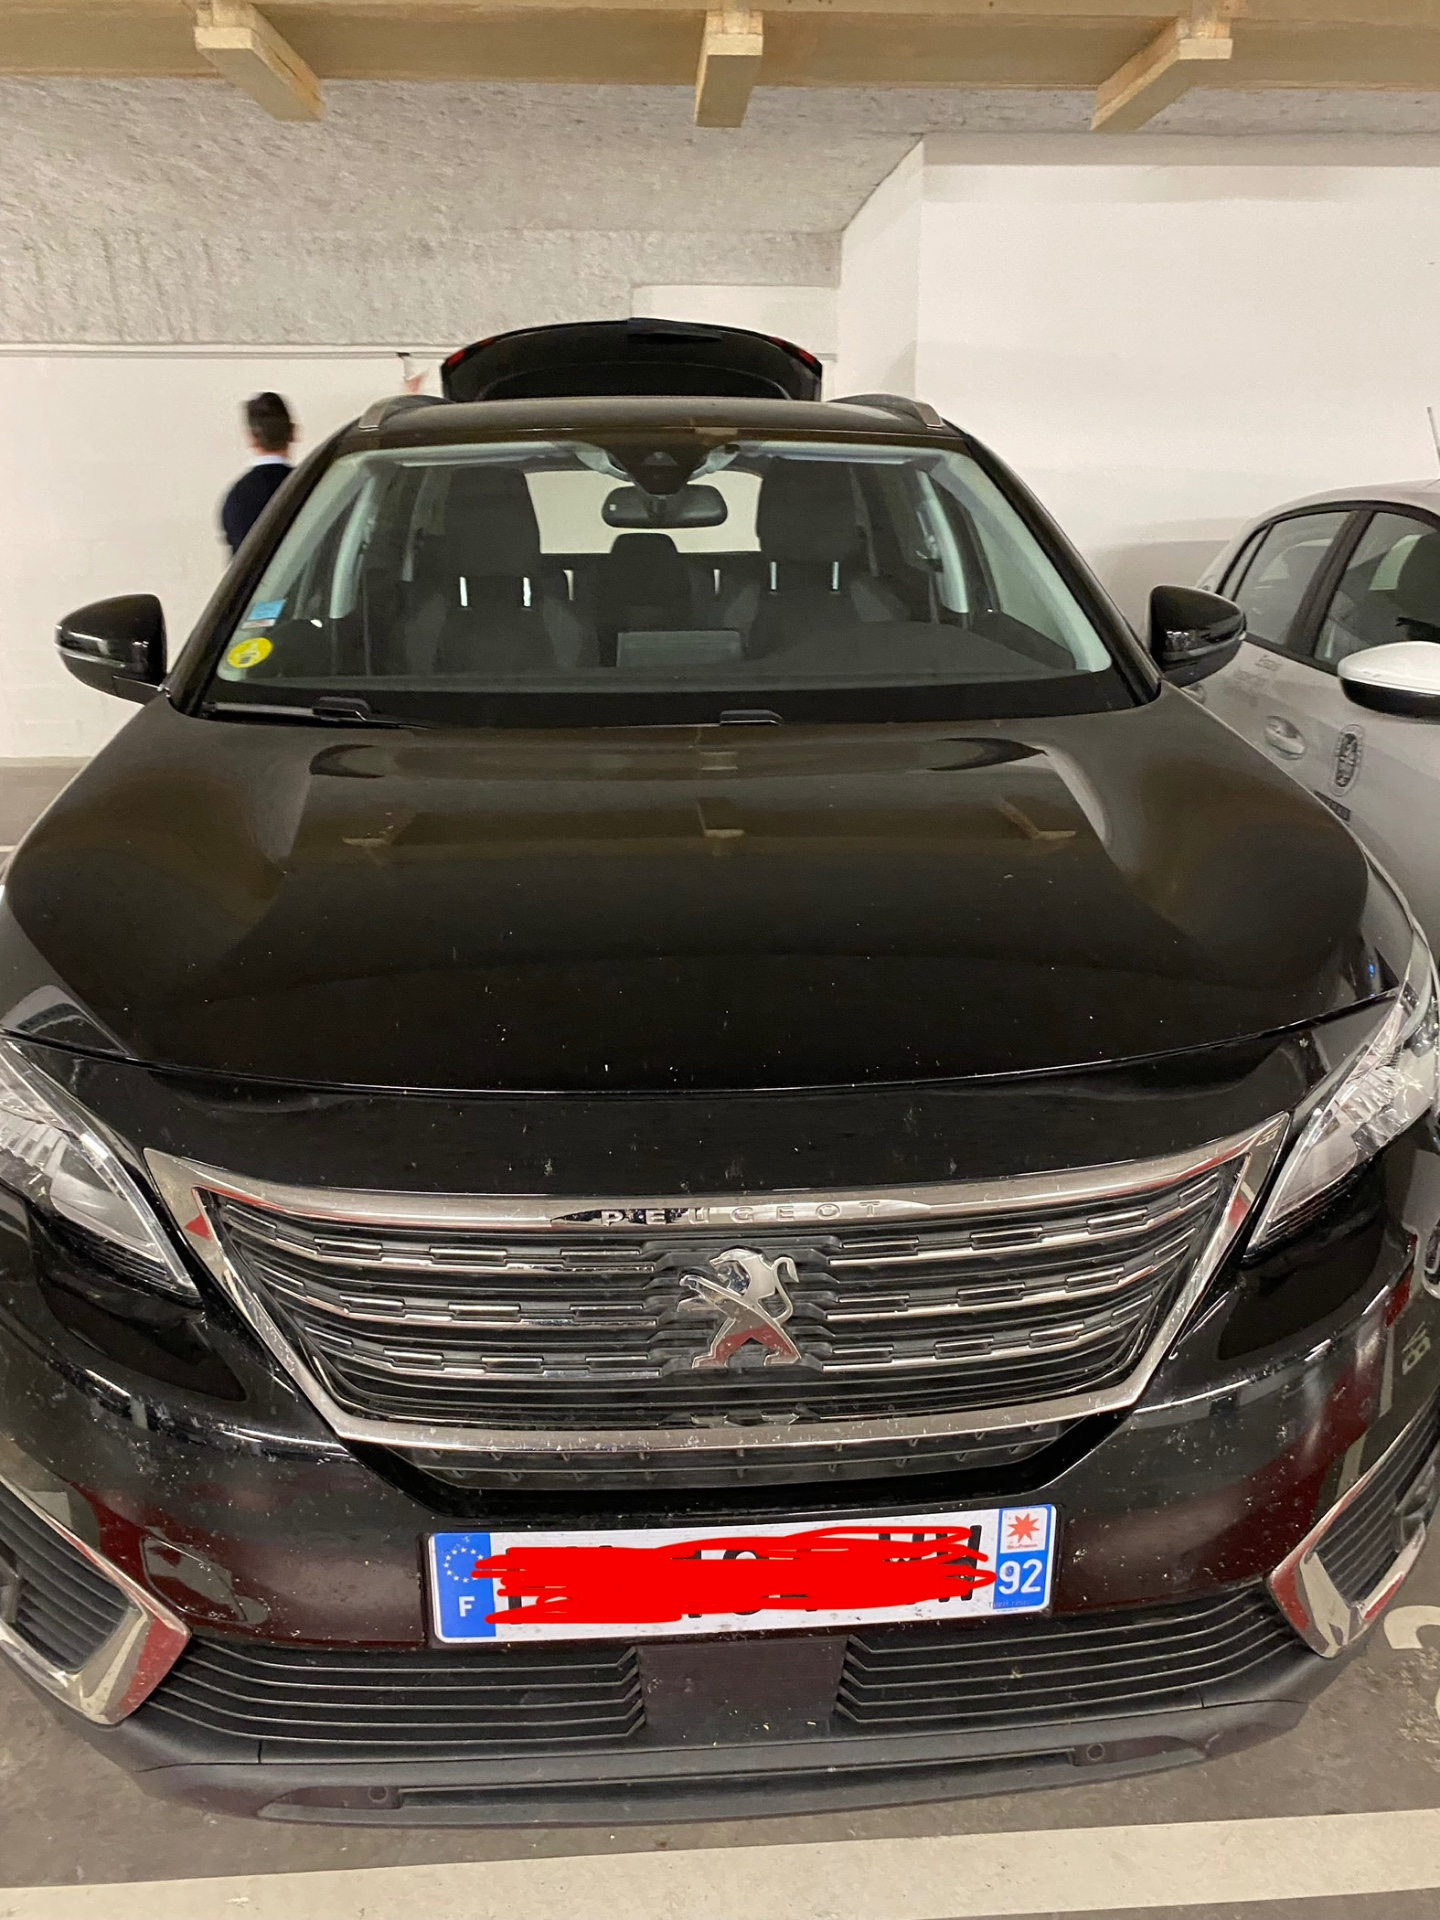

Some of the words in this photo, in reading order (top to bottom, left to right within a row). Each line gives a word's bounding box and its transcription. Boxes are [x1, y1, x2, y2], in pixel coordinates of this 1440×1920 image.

[600, 1200, 882, 1227] PEUGEOT
[998, 1558, 1043, 1595] 92
[458, 1595, 476, 1617] F
